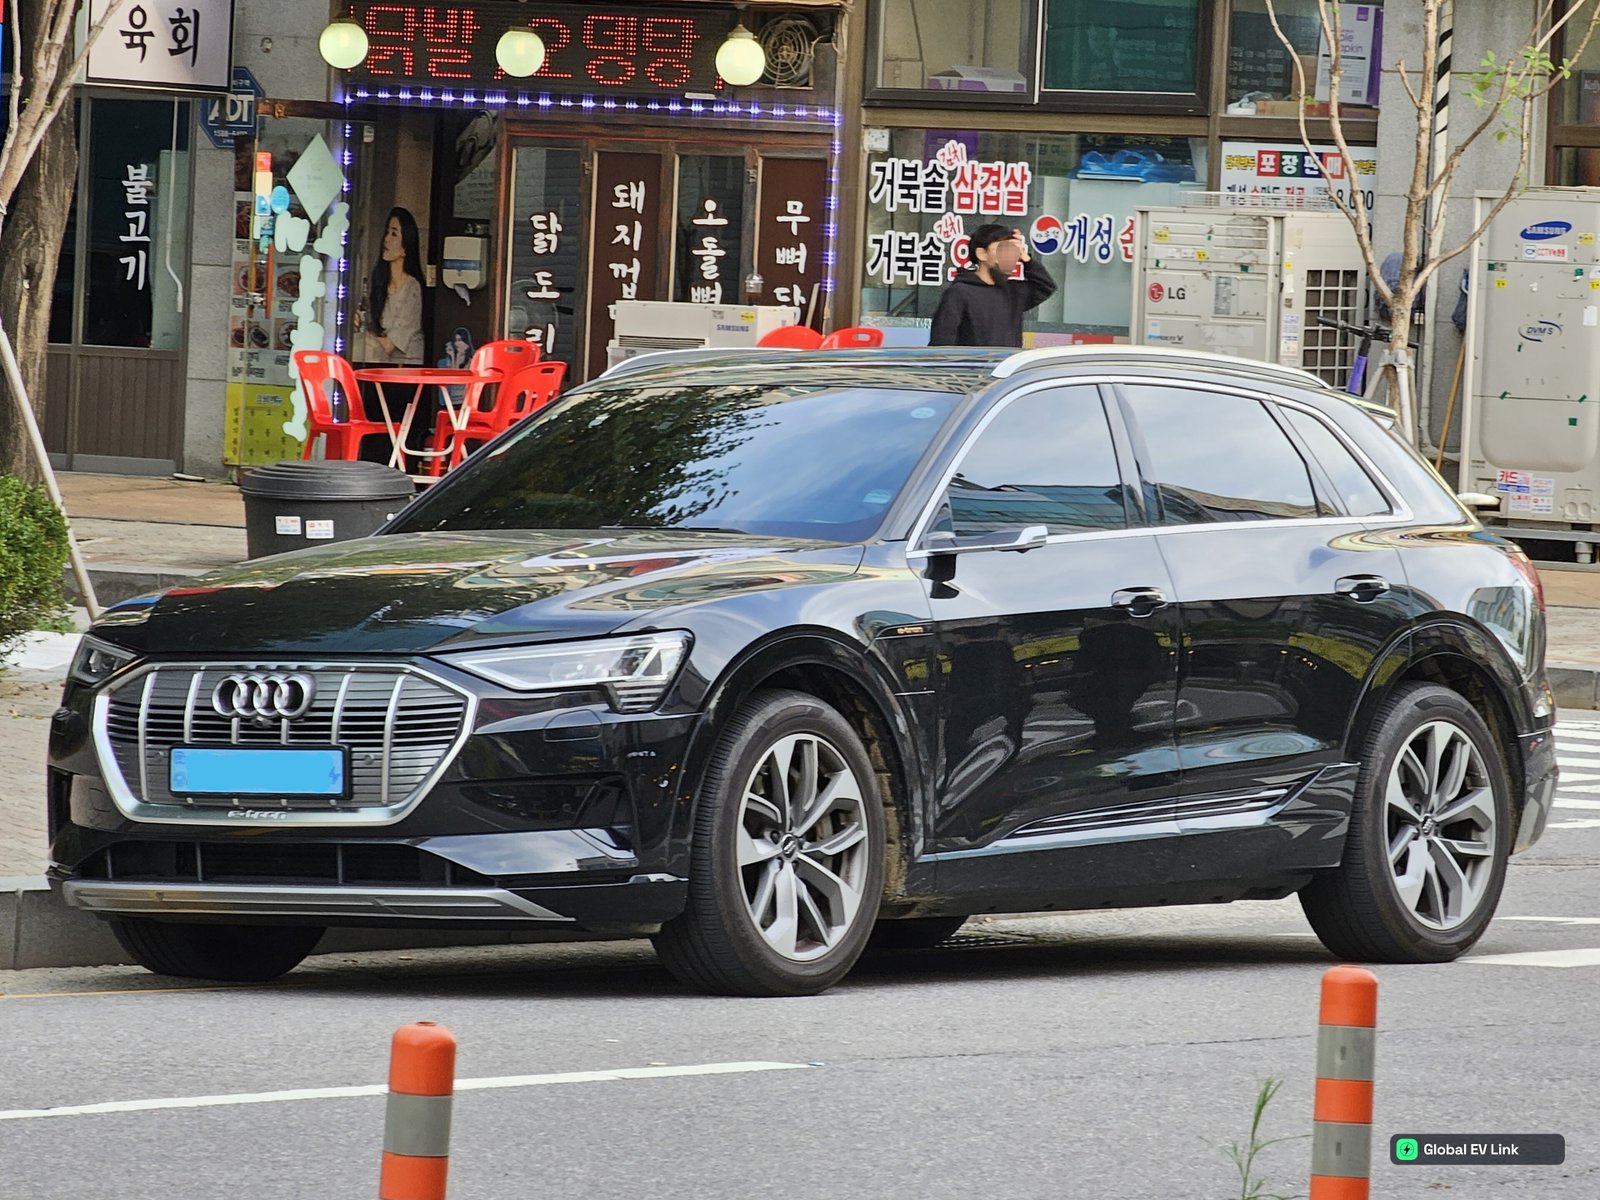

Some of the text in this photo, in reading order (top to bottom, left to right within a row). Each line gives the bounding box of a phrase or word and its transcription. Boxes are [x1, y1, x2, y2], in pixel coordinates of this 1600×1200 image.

[119, 4, 200, 68] 육회
[941, 144, 963, 166] 김치
[873, 161, 1029, 212] 거북솥 삼겹살
[119, 164, 154, 290] 불고기
[937, 216, 960, 238] 김치
[1065, 216, 1113, 260] 개성
[870, 234, 943, 282] 거북솥
[1168, 287, 1186, 300] LG
[716, 324, 749, 333] SAMSUNG
[1526, 326, 1546, 335] DVM
